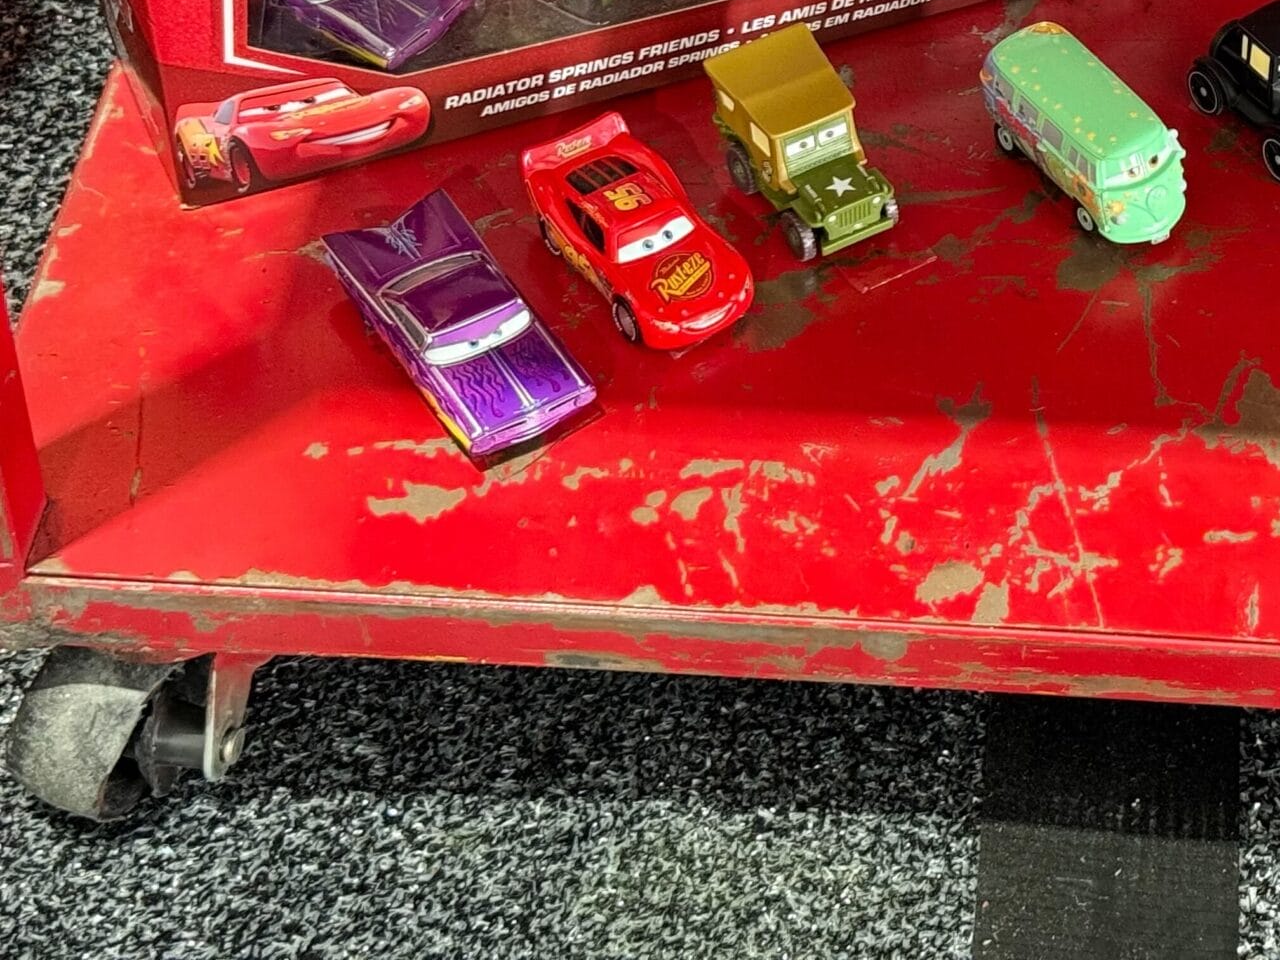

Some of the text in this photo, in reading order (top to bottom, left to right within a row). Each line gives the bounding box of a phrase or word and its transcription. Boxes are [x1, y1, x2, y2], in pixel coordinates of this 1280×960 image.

[444, 73, 544, 110] RADIATOR
[548, 50, 634, 83] SPRINGS
[638, 29, 721, 61] FRIENDS
[740, 14, 777, 35] LES
[778, 0, 827, 25] AMIS
[480, 90, 550, 117] AMIGOS
[552, 83, 577, 100] DE
[579, 60, 665, 92] RADIADOR
[667, 40, 740, 69] SPRINGS
[823, 12, 850, 29] EM
